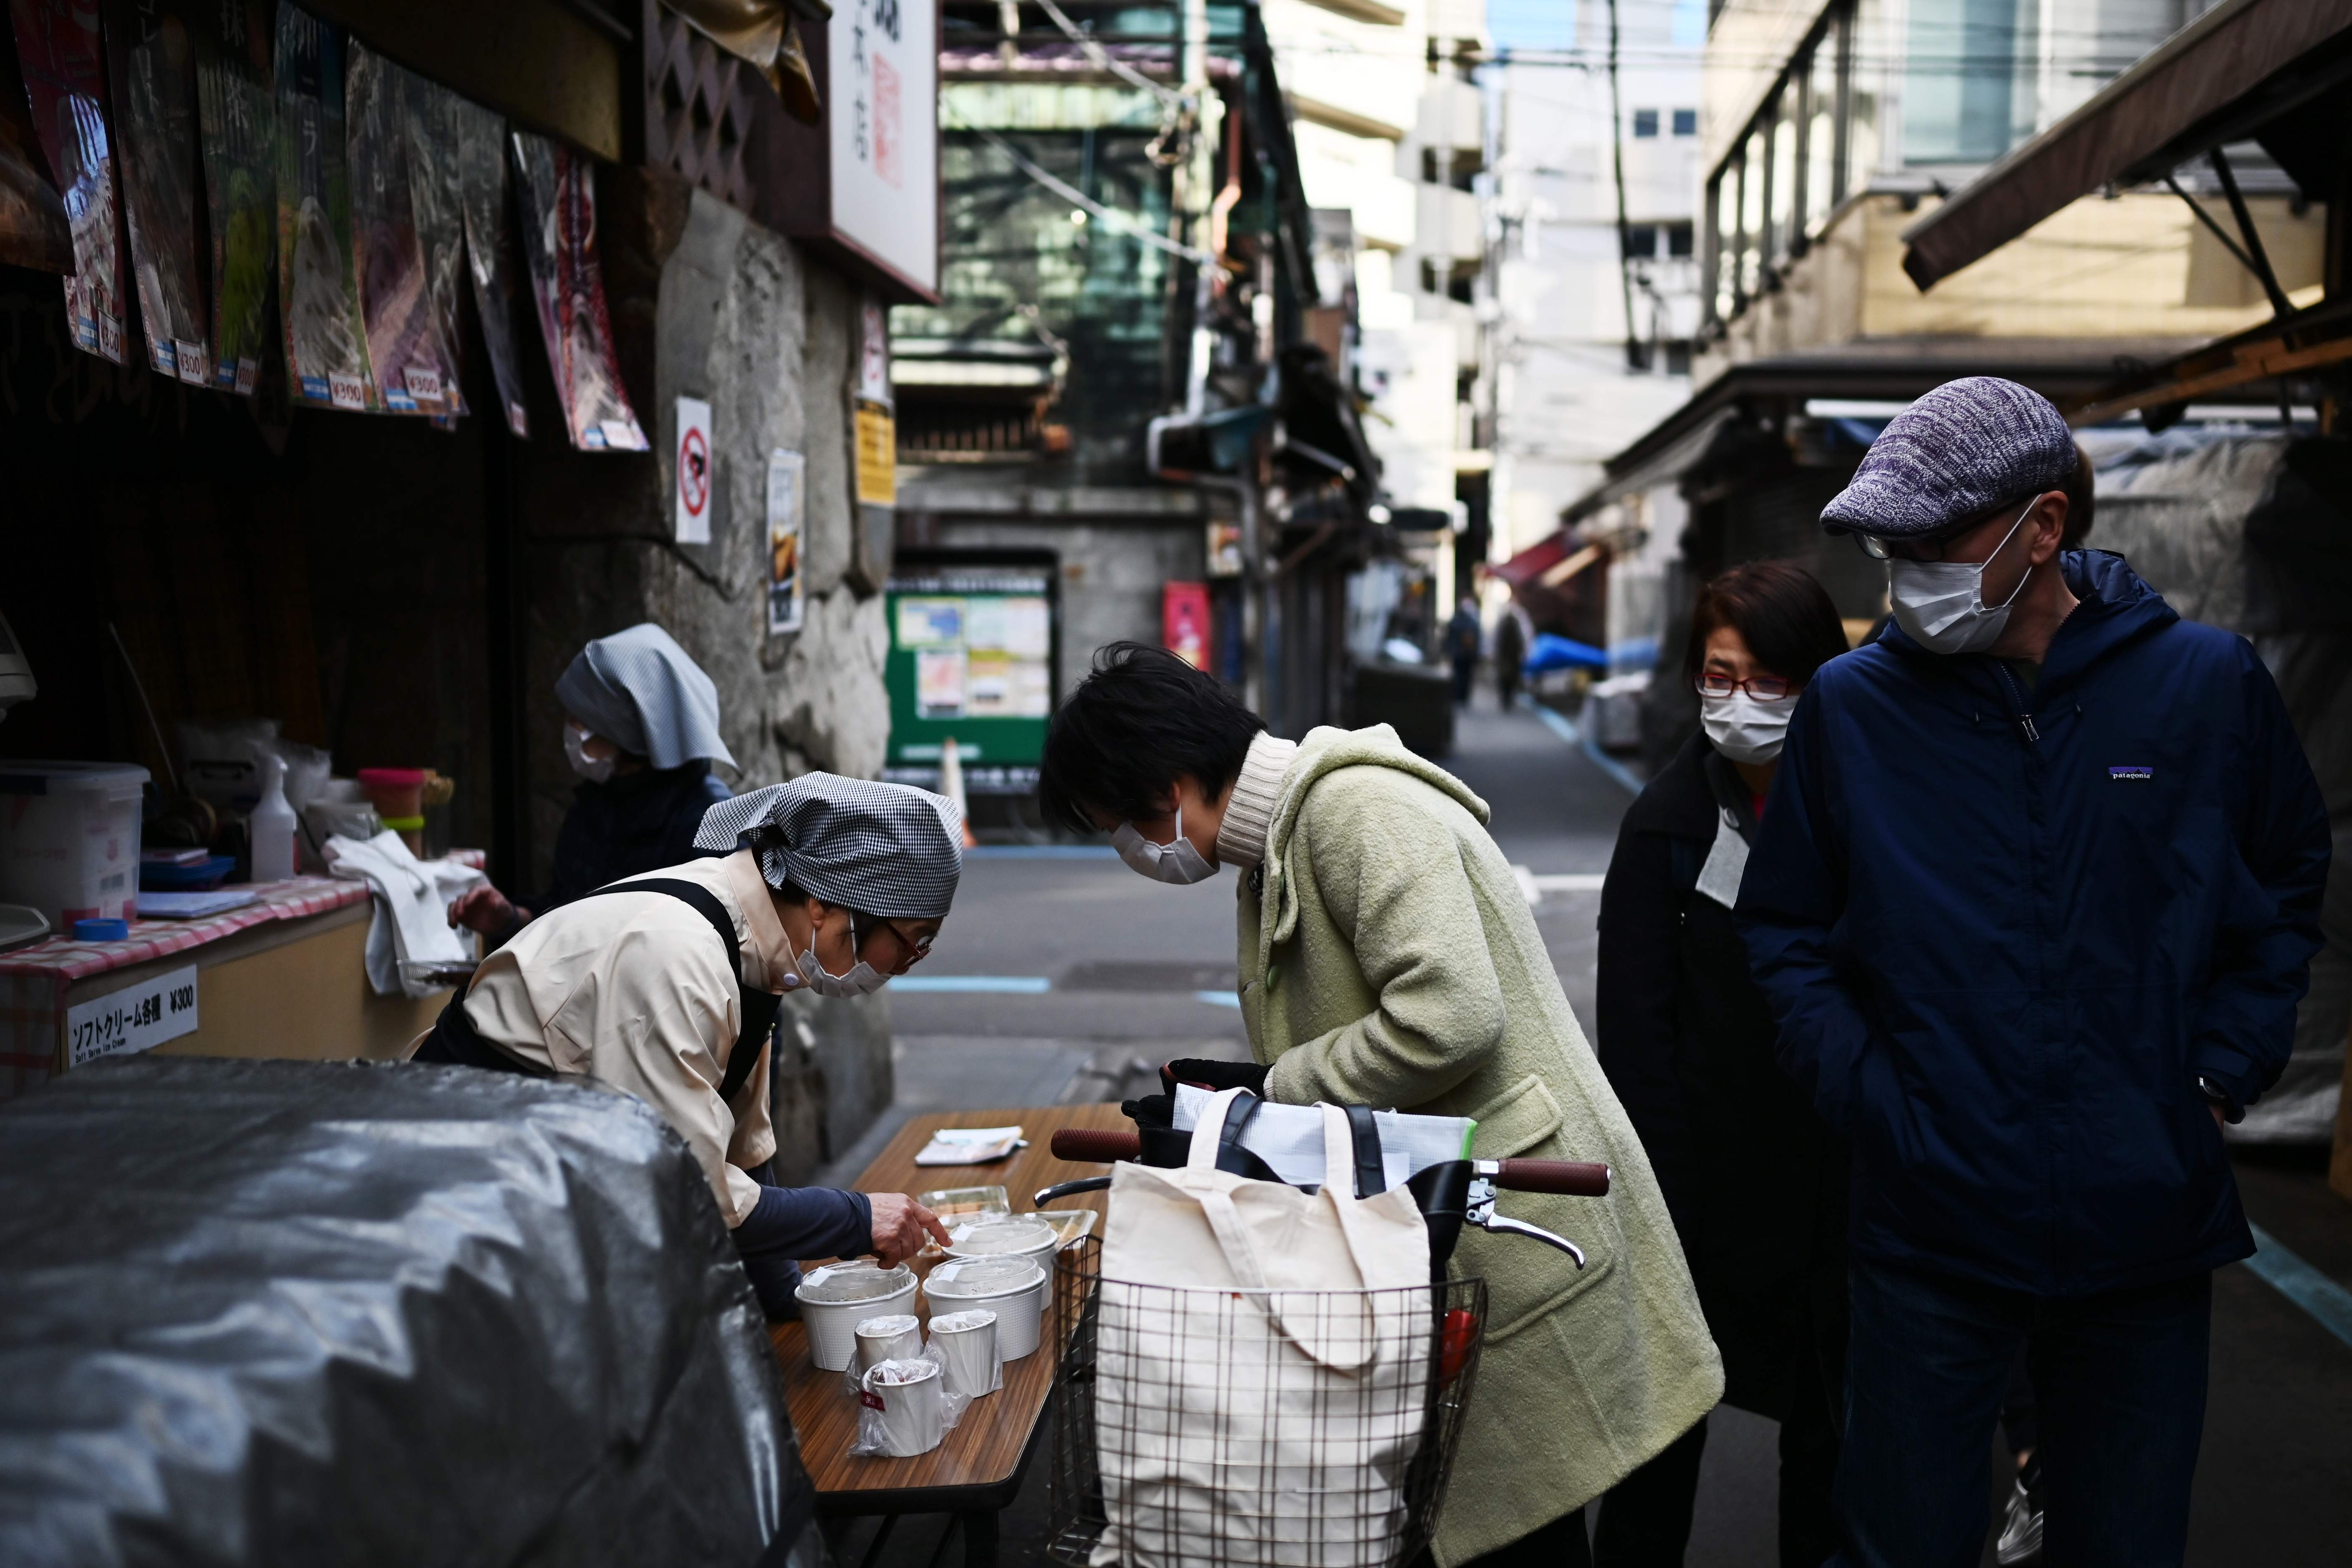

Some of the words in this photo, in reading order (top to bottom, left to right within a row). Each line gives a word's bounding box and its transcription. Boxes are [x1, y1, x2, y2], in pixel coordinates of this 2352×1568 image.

[100, 323, 119, 353] ¥300
[178, 352, 201, 375] ¥300
[238, 366, 254, 386] ¥300
[407, 375, 438, 393] ¥300
[332, 381, 361, 402] ¥300
[73, 993, 161, 1051] ソフトクリーム各種
[169, 983, 193, 1014] ¥300
[75, 1052, 86, 1064] Soft
[88, 1048, 101, 1059] Serve
[112, 1037, 126, 1049] Cream
